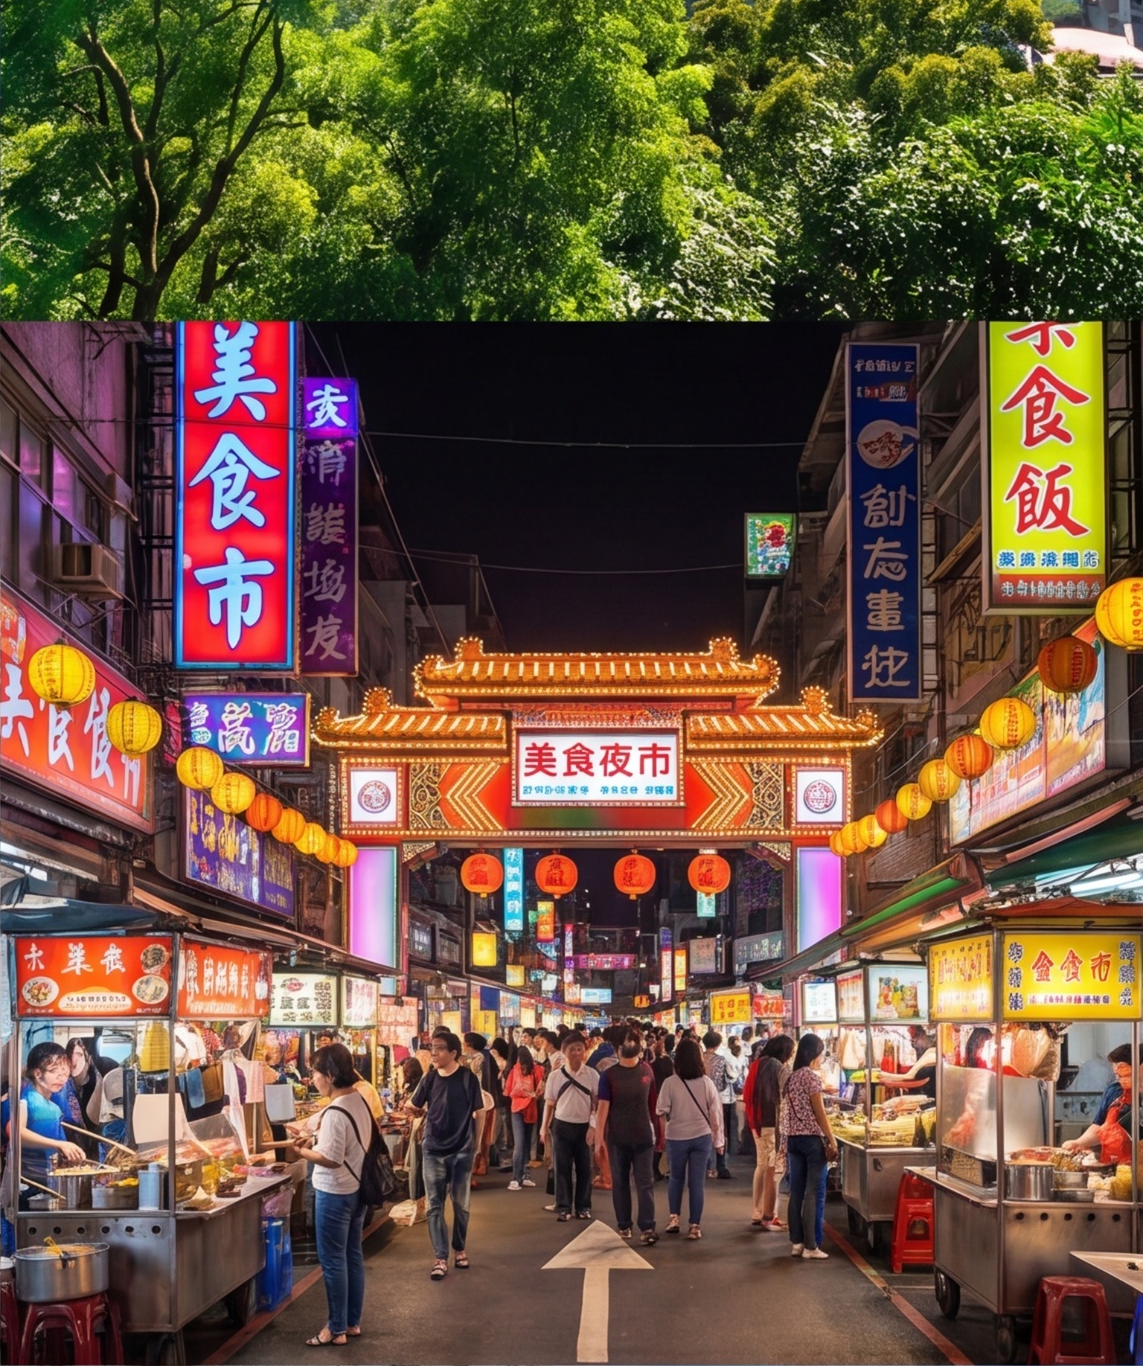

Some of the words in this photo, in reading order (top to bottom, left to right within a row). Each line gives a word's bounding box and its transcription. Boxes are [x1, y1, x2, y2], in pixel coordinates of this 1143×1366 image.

[188, 321, 281, 650] 美食市
[524, 742, 672, 778] 美食夜市
